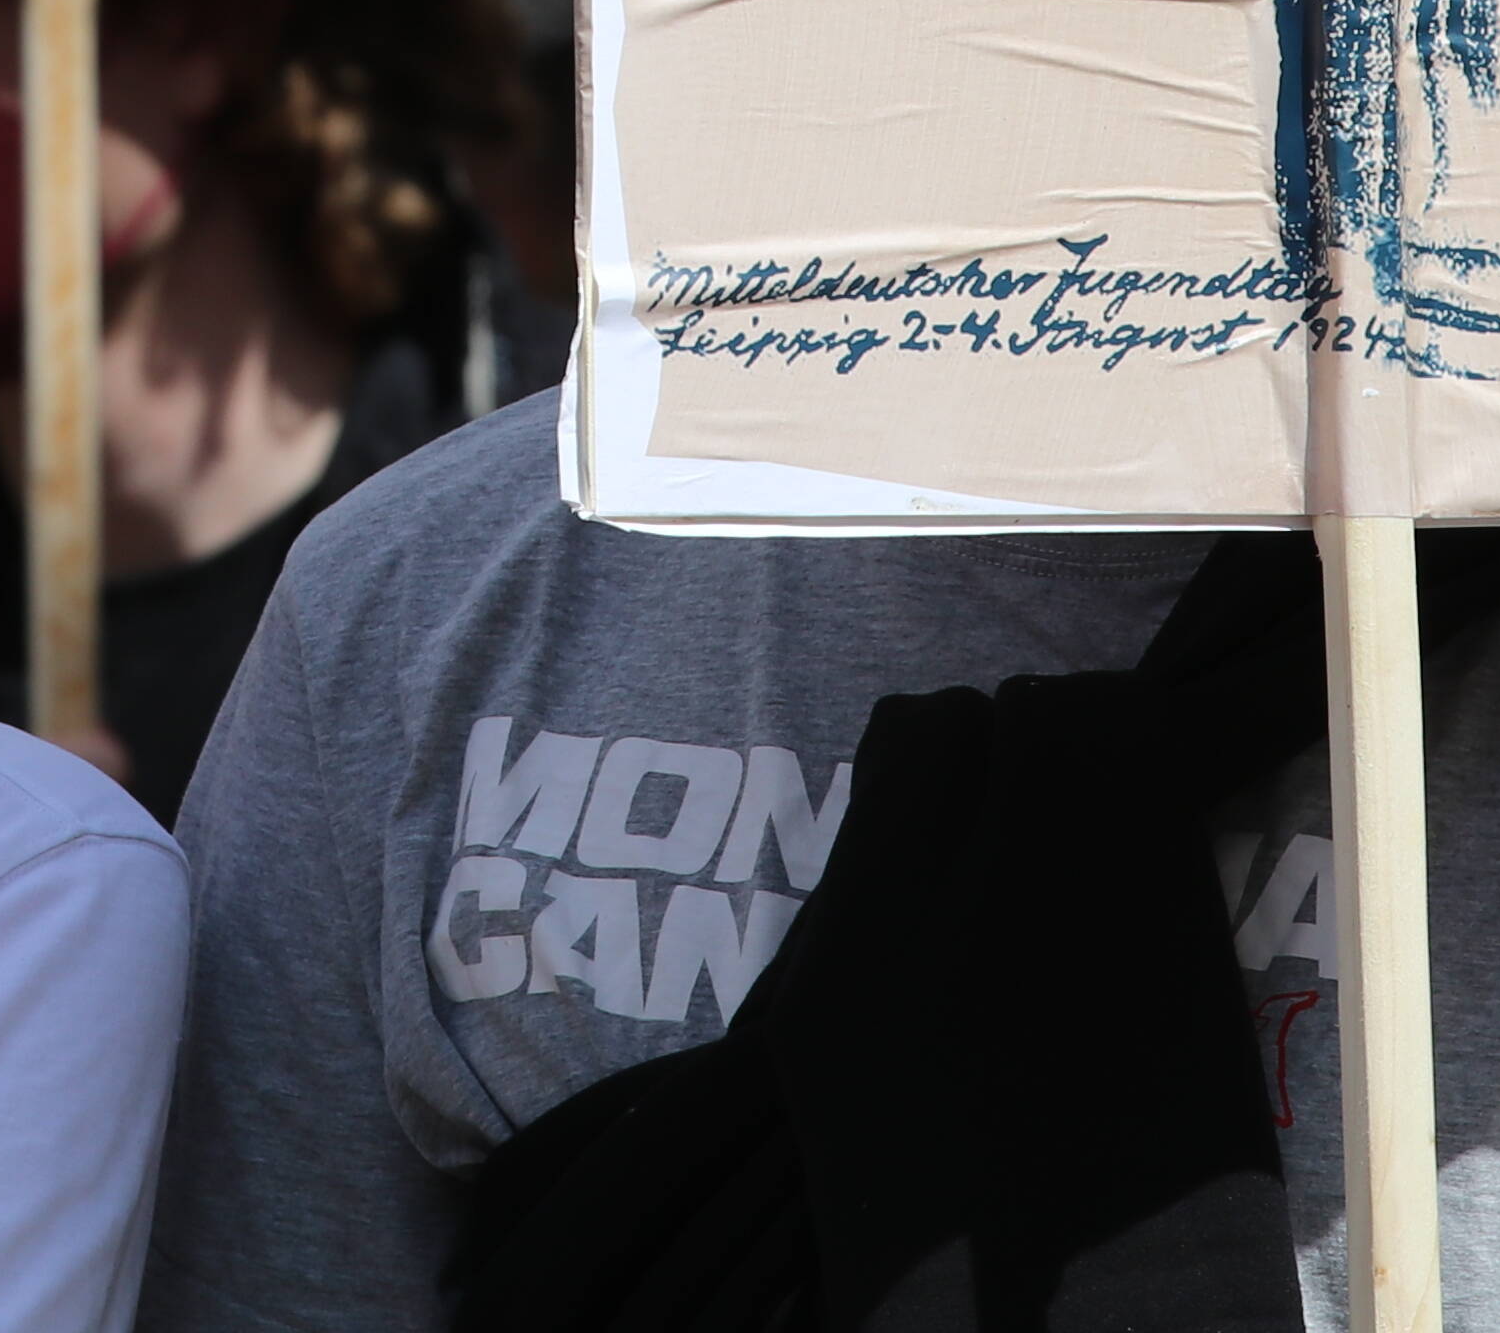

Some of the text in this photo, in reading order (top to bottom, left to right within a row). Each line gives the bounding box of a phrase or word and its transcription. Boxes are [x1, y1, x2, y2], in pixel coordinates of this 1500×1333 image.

[1036, 234, 1342, 321] Jugendtag
[654, 309, 890, 374] Leipzig
[1009, 309, 1267, 372] August
[1273, 314, 1387, 359] 1924
